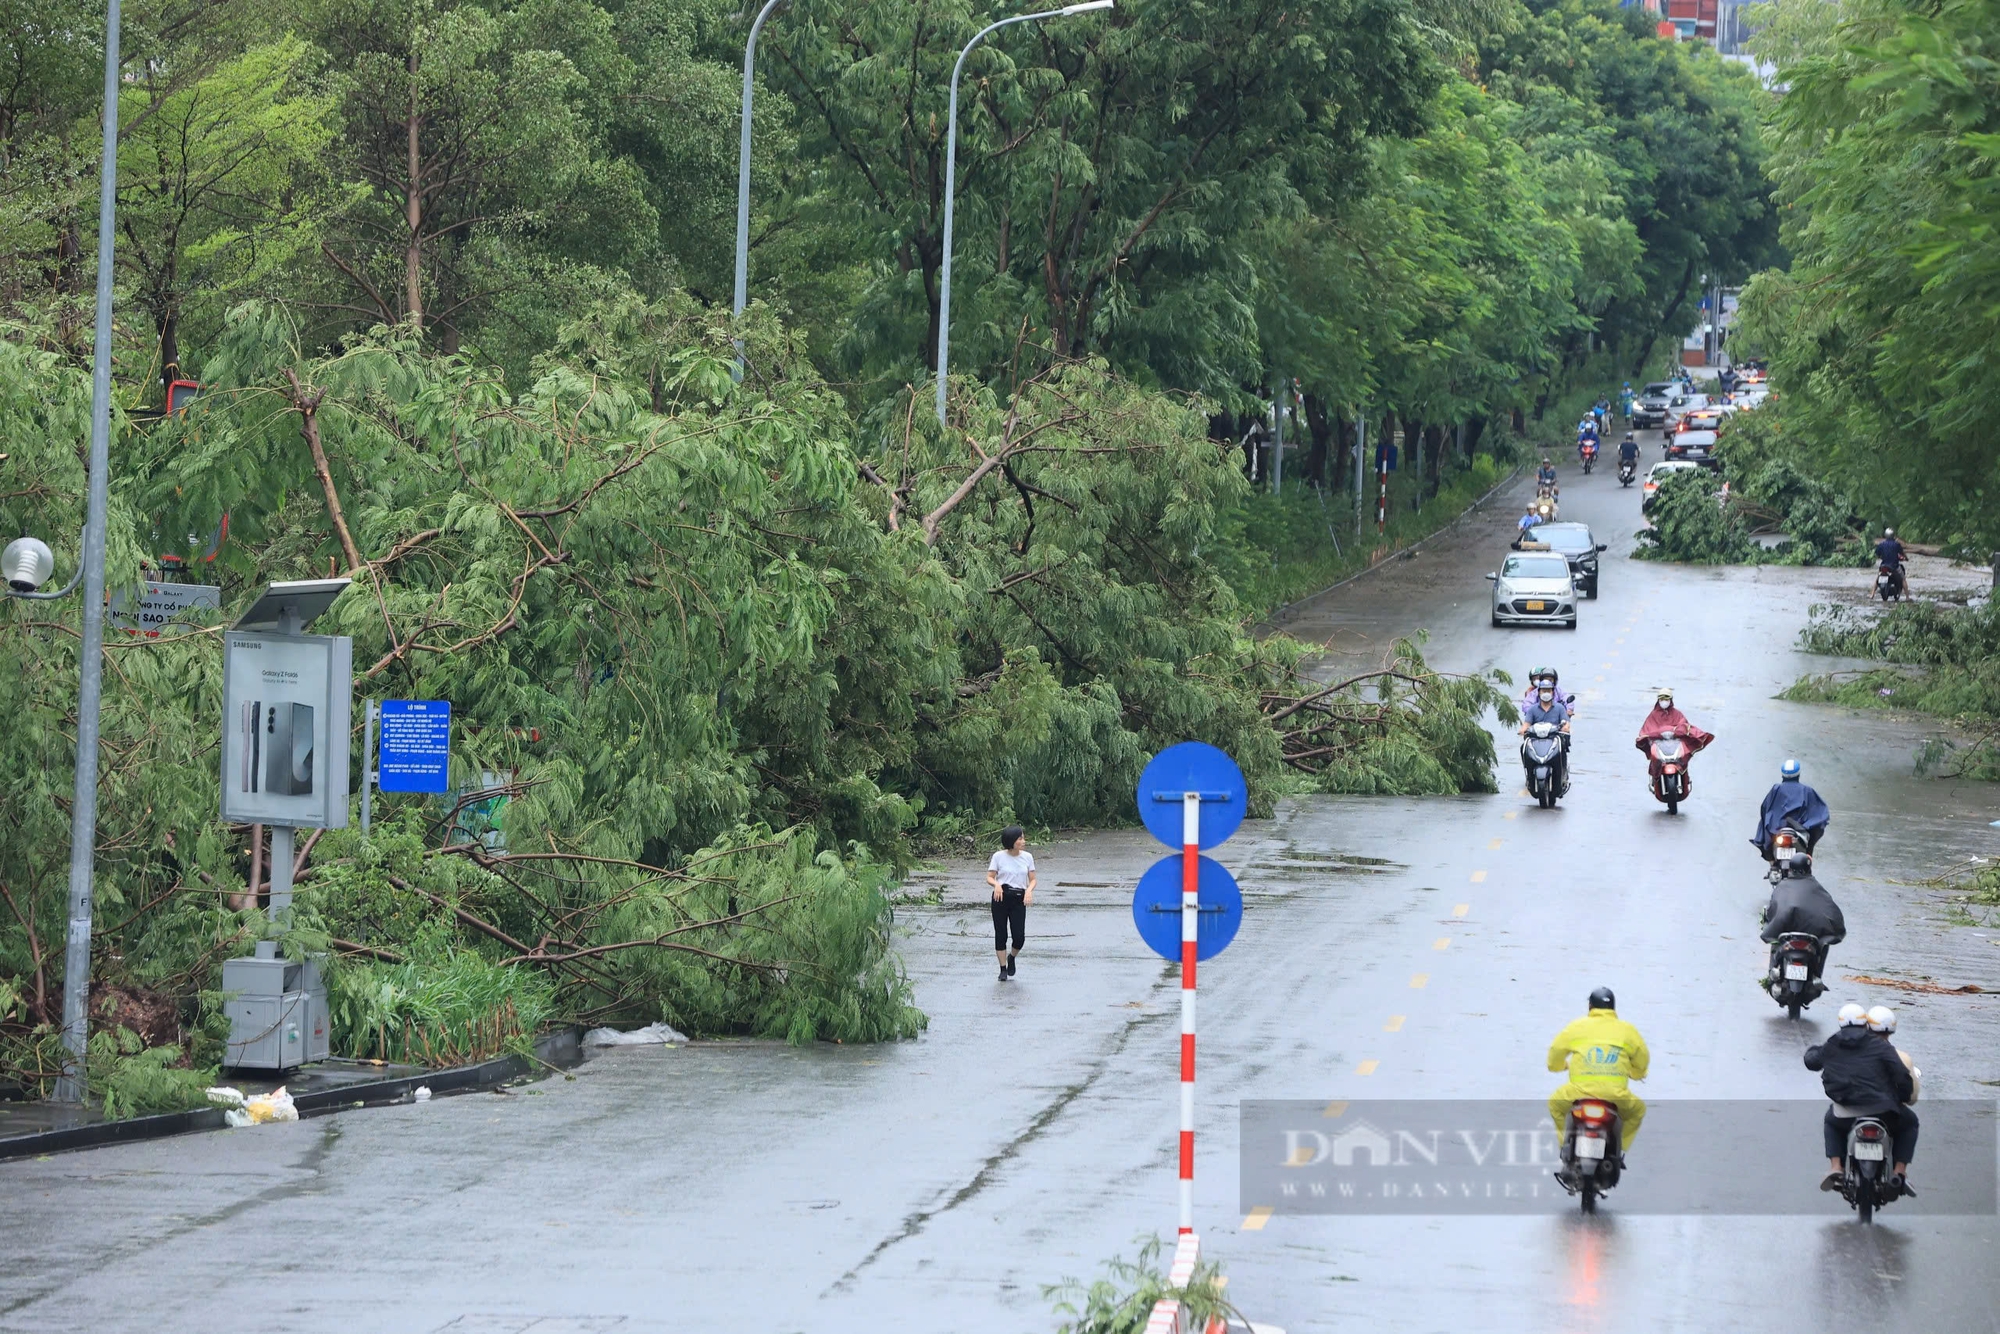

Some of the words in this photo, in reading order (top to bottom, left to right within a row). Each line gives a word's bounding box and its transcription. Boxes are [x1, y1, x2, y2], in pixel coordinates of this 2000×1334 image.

[143, 613, 164, 623] SAO
[233, 641, 262, 649] SAMSUNG
[262, 669, 280, 678] Galaxy
